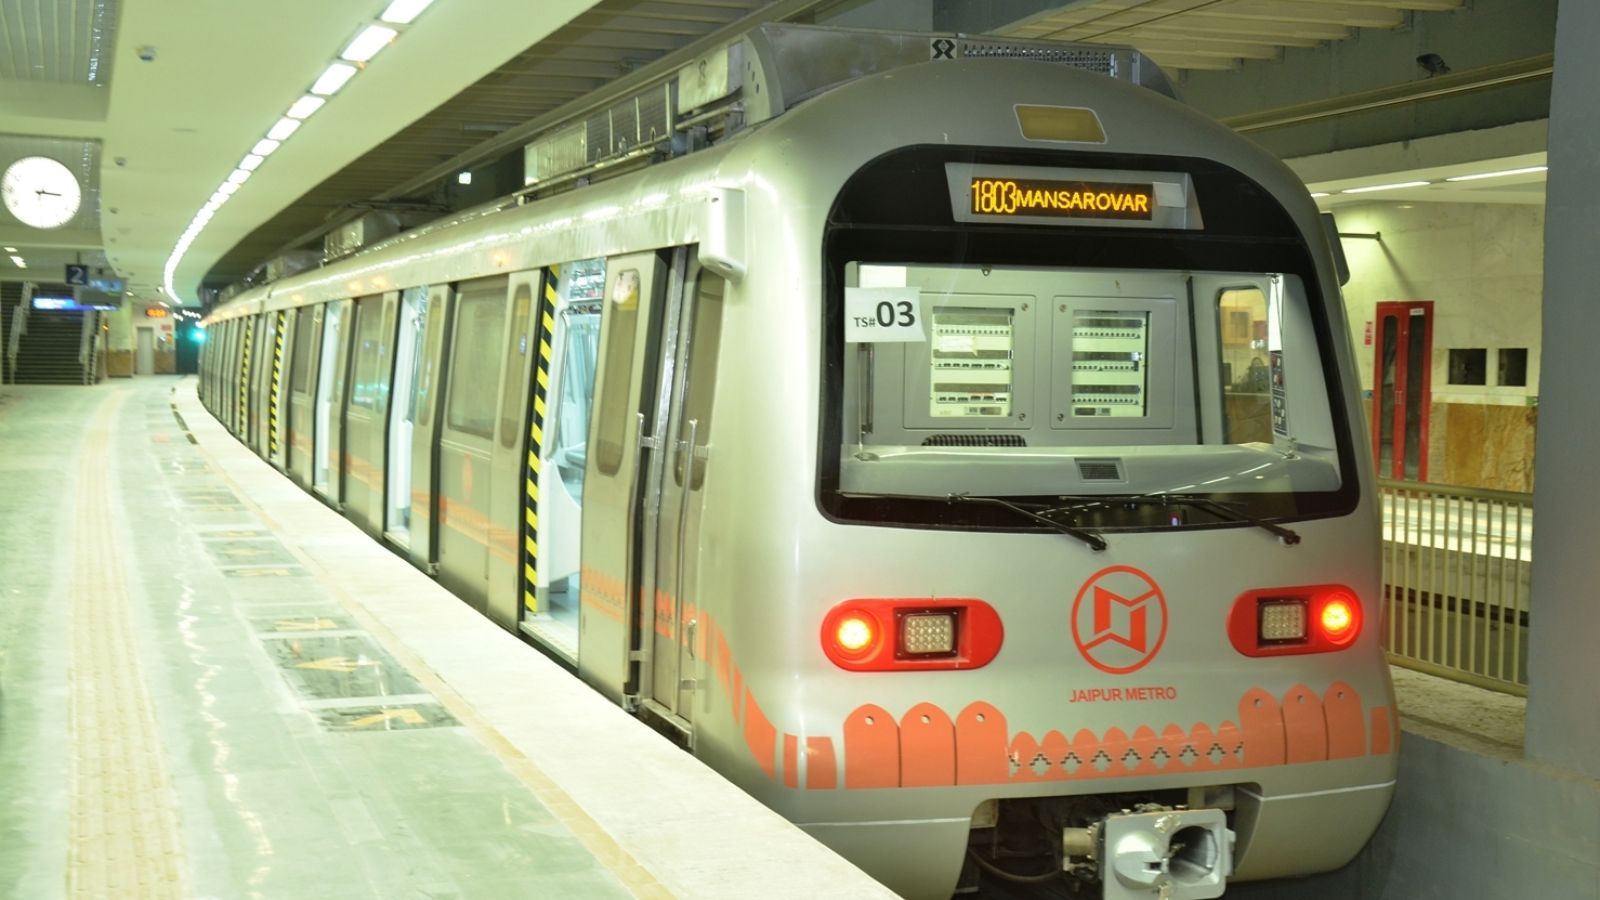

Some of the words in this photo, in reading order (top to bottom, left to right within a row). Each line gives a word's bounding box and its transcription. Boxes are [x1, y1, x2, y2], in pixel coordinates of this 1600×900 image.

[70, 266, 85, 284] 2
[1069, 687, 1122, 703] JAIPUR
[1125, 686, 1177, 701] METRO
